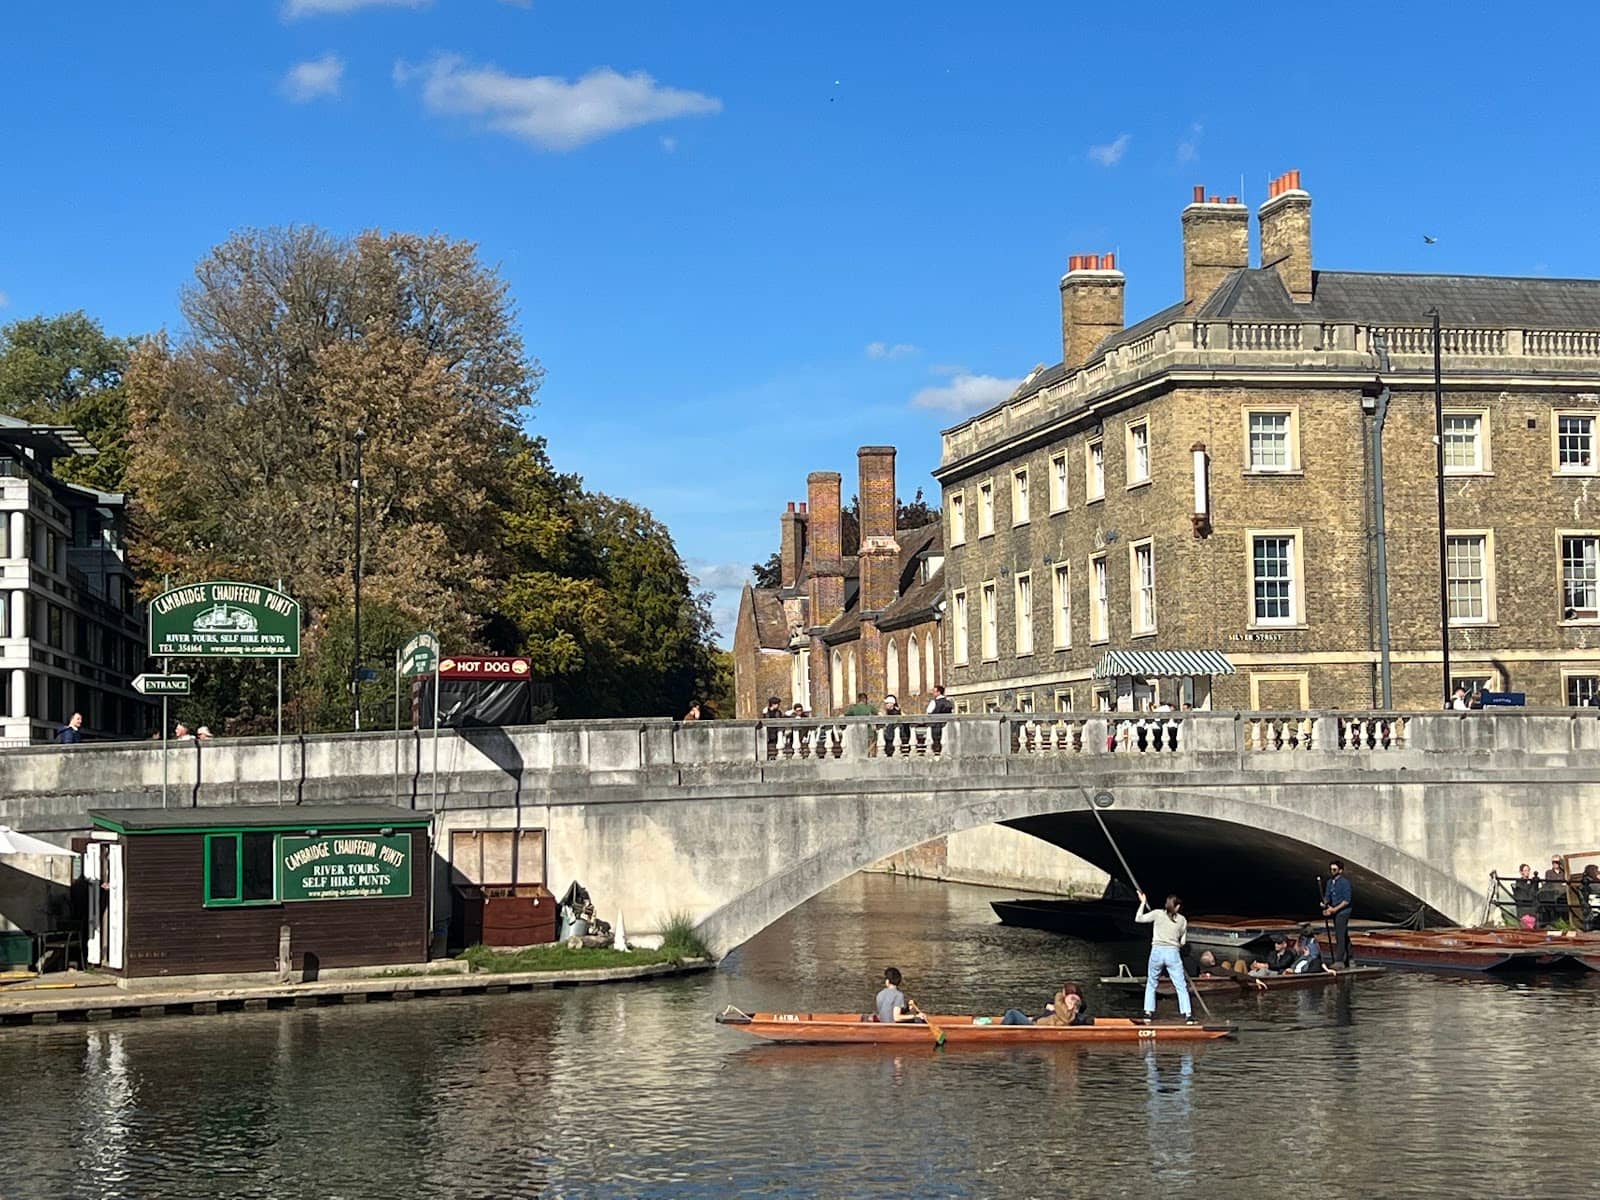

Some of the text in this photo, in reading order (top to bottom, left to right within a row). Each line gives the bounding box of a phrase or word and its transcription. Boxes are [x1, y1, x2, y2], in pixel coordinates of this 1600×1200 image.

[155, 585, 294, 617] CAMBRIDGE CHAUFFEUR PUNTS
[166, 634, 190, 643] RIVER
[220, 634, 239, 643] SELF
[240, 634, 259, 643] HIRE
[261, 635, 285, 644] PUNTS
[159, 644, 174, 653] TEL
[457, 661, 510, 672] HOT DOG
[145, 680, 187, 689] ENTRANCE
[284, 839, 405, 871] CAMBRIDGE CHAUFFEUR PUNTS
[313, 863, 380, 876] RIVER TOURS
[302, 874, 391, 888] SELF HIRE PUNTS
